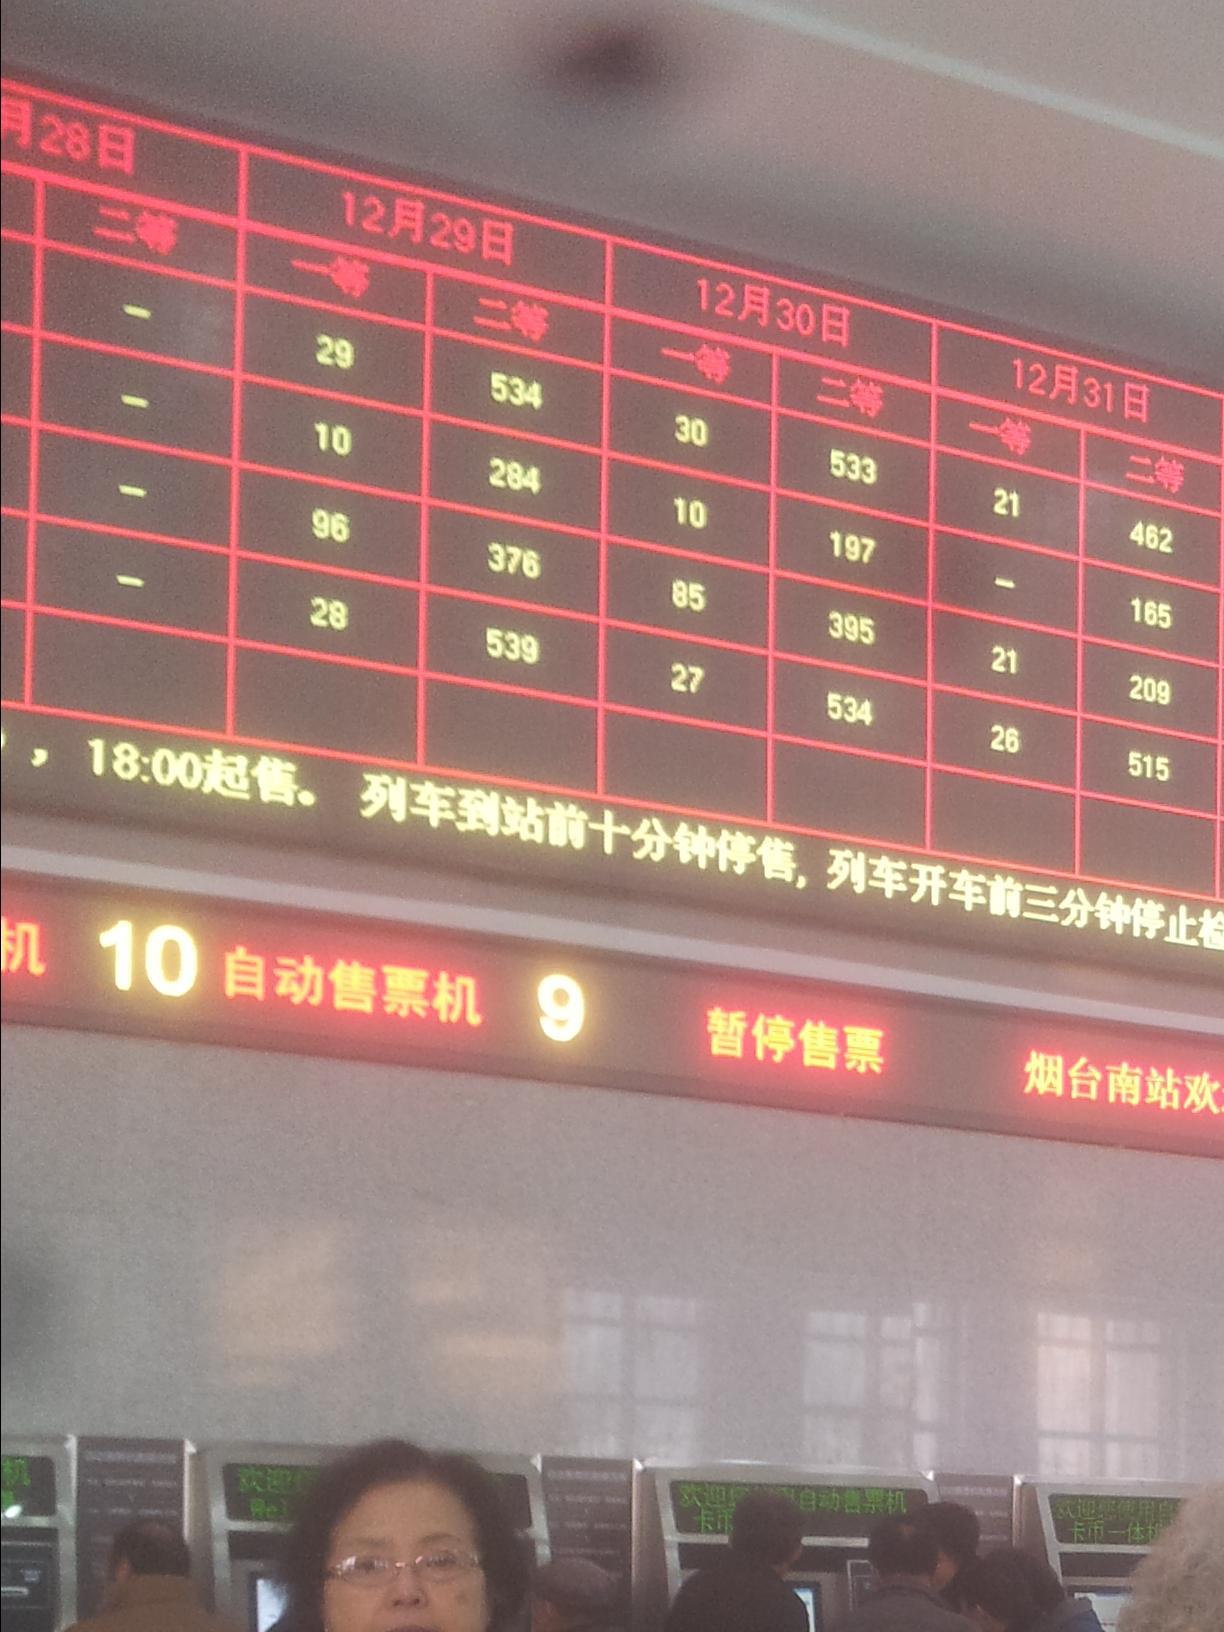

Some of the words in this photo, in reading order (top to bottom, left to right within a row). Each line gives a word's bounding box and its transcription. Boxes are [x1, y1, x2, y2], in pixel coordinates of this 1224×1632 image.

[93, 204, 180, 255] 二等
[341, 189, 515, 267] 12月29日
[291, 254, 370, 298] 一等
[473, 297, 550, 342] 二等
[696, 277, 851, 347] 12月30日
[660, 343, 731, 385] 一等
[816, 376, 884, 418] 二等
[1011, 358, 1151, 424] 12月31日
[315, 334, 355, 370] 29
[490, 371, 544, 410] 534
[674, 414, 709, 447] 30
[829, 448, 878, 485] 533
[992, 487, 1020, 518] 21
[1128, 520, 1174, 554] 462
[968, 417, 1032, 455] 一等
[1125, 454, 1186, 494] 二等
[314, 421, 352, 456] 10
[488, 456, 542, 495] 284
[673, 496, 708, 530] 10
[829, 530, 877, 564] 197
[1130, 596, 1173, 630] 165
[311, 508, 351, 544] 96
[487, 541, 542, 580] 376
[671, 579, 707, 612] 85
[828, 610, 876, 646] 395
[990, 644, 1018, 675] 21
[1128, 673, 1172, 706] 209
[309, 596, 349, 631] 28
[485, 627, 540, 665] 539
[670, 662, 705, 694] 27
[826, 691, 875, 727] 534
[989, 723, 1021, 755] 26
[1127, 749, 1171, 783] 515
[98, 918, 200, 998] 10
[223, 944, 483, 1027] 自动售票机
[536, 972, 587, 1044] 9
[705, 1006, 885, 1075] 暂停售票
